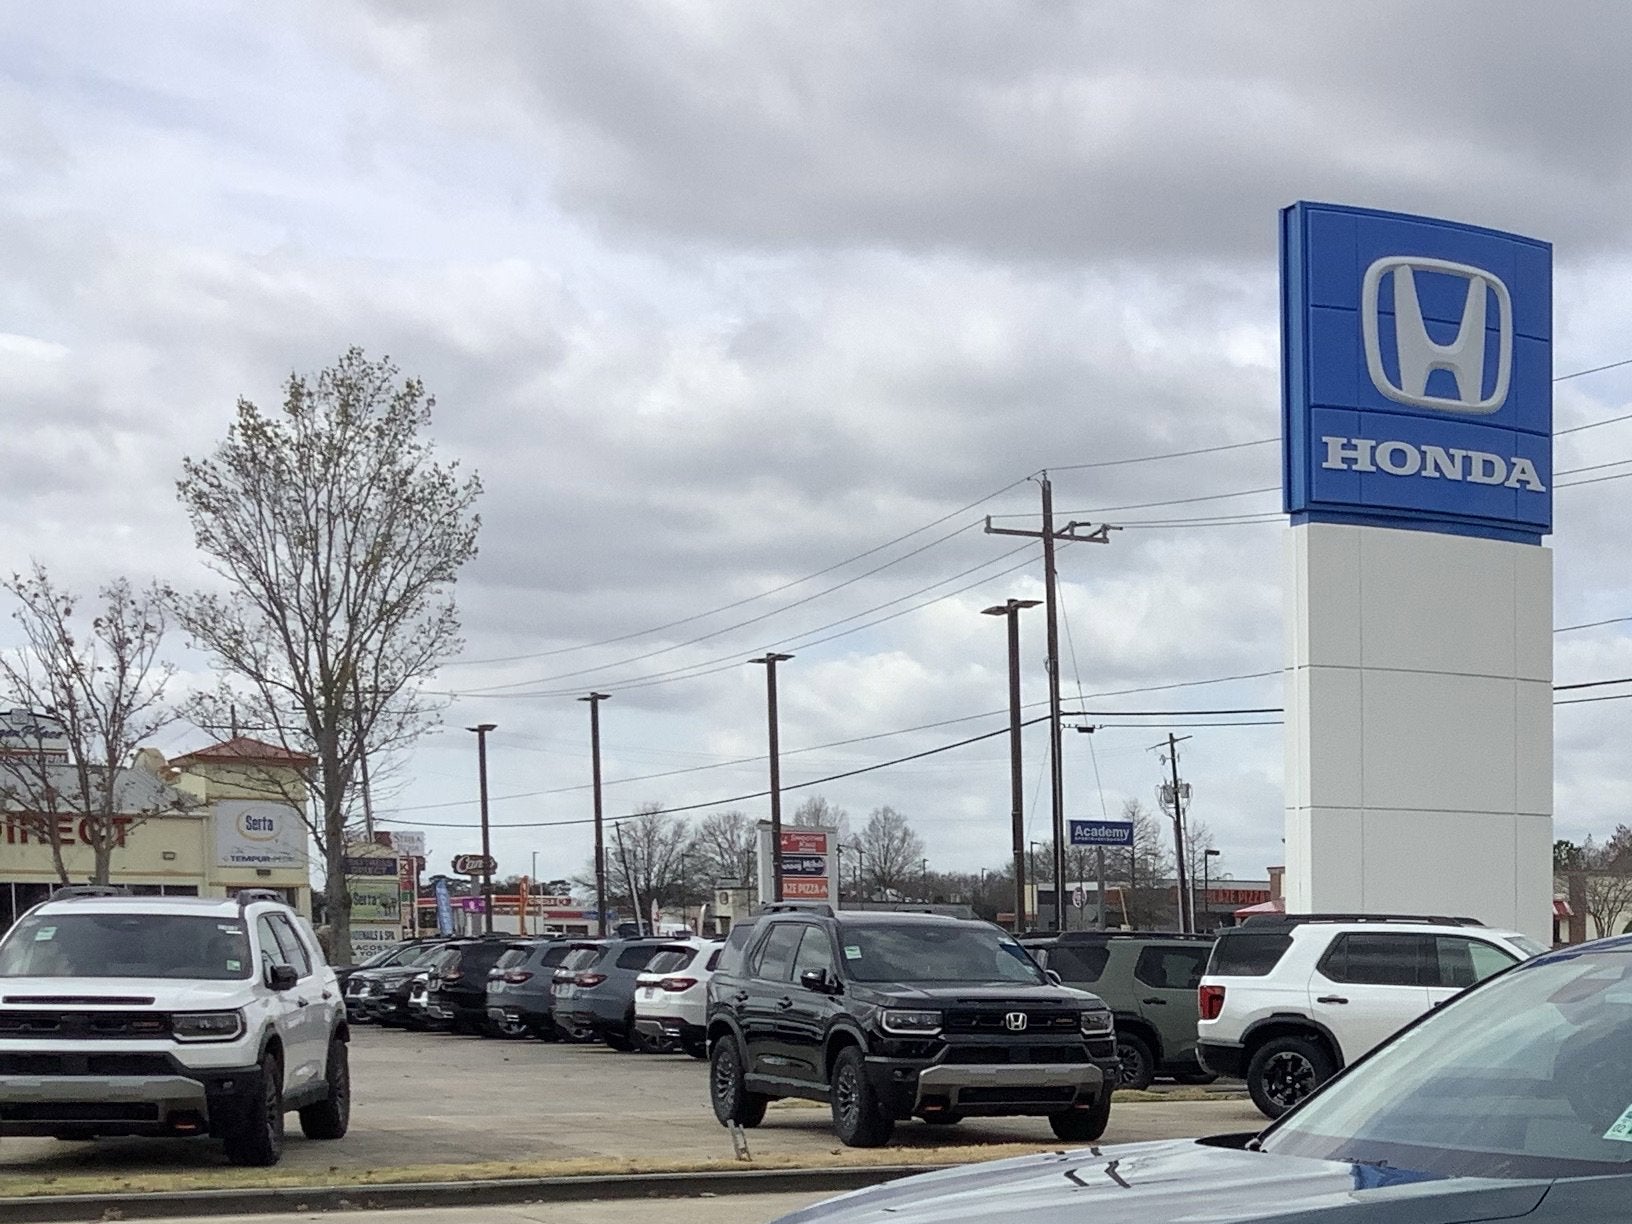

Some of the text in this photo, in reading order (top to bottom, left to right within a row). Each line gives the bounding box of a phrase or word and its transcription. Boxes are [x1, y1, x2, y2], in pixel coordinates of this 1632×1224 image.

[1322, 436, 1546, 492] HONDA
[0, 813, 133, 848] IRECT
[245, 814, 273, 832] Serta
[1074, 825, 1130, 841] Academy
